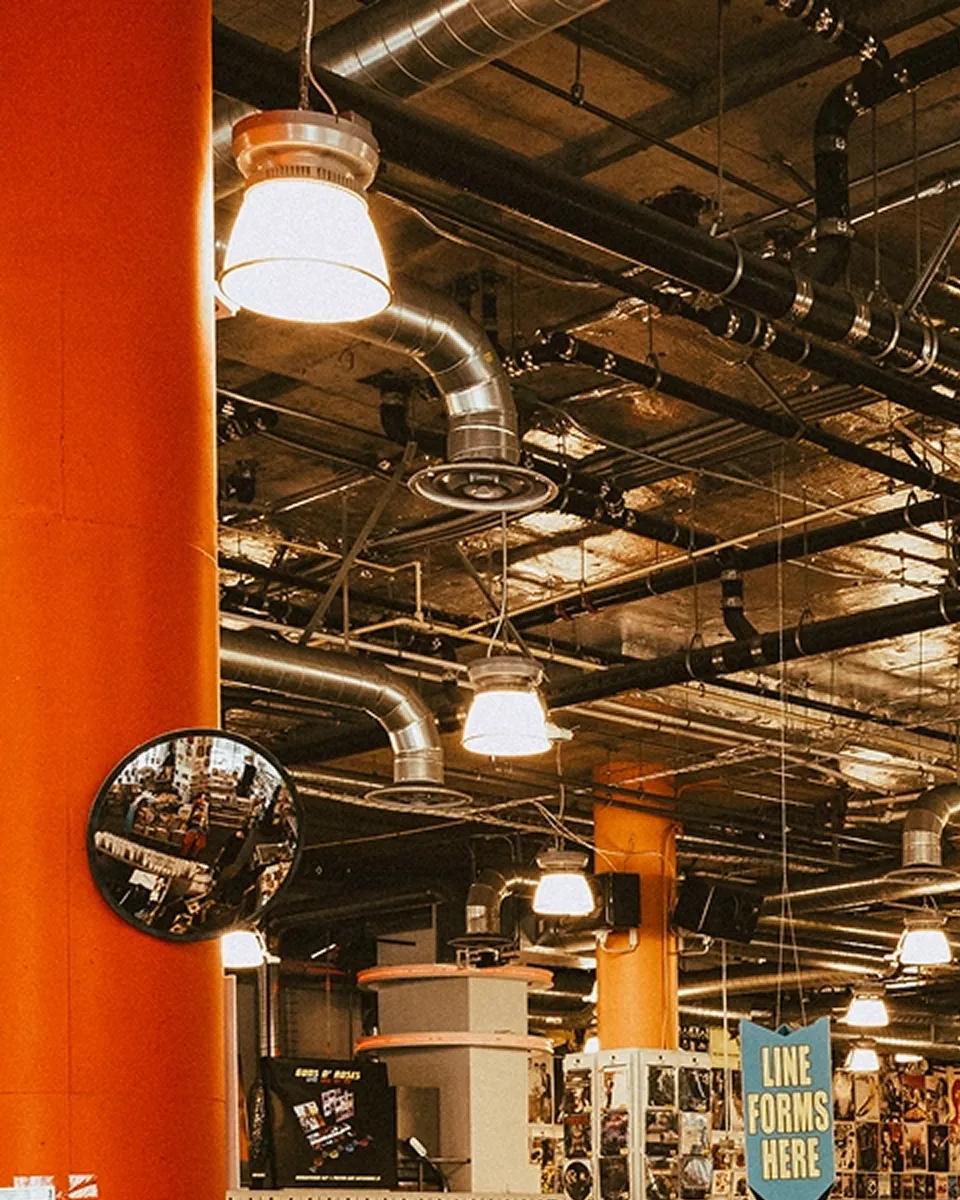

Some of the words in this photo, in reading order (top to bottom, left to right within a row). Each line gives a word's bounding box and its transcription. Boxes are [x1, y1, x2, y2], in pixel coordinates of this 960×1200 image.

[761, 1044, 813, 1088] LINE
[746, 1090, 830, 1135] FORMS
[761, 1136, 821, 1181] HERE
